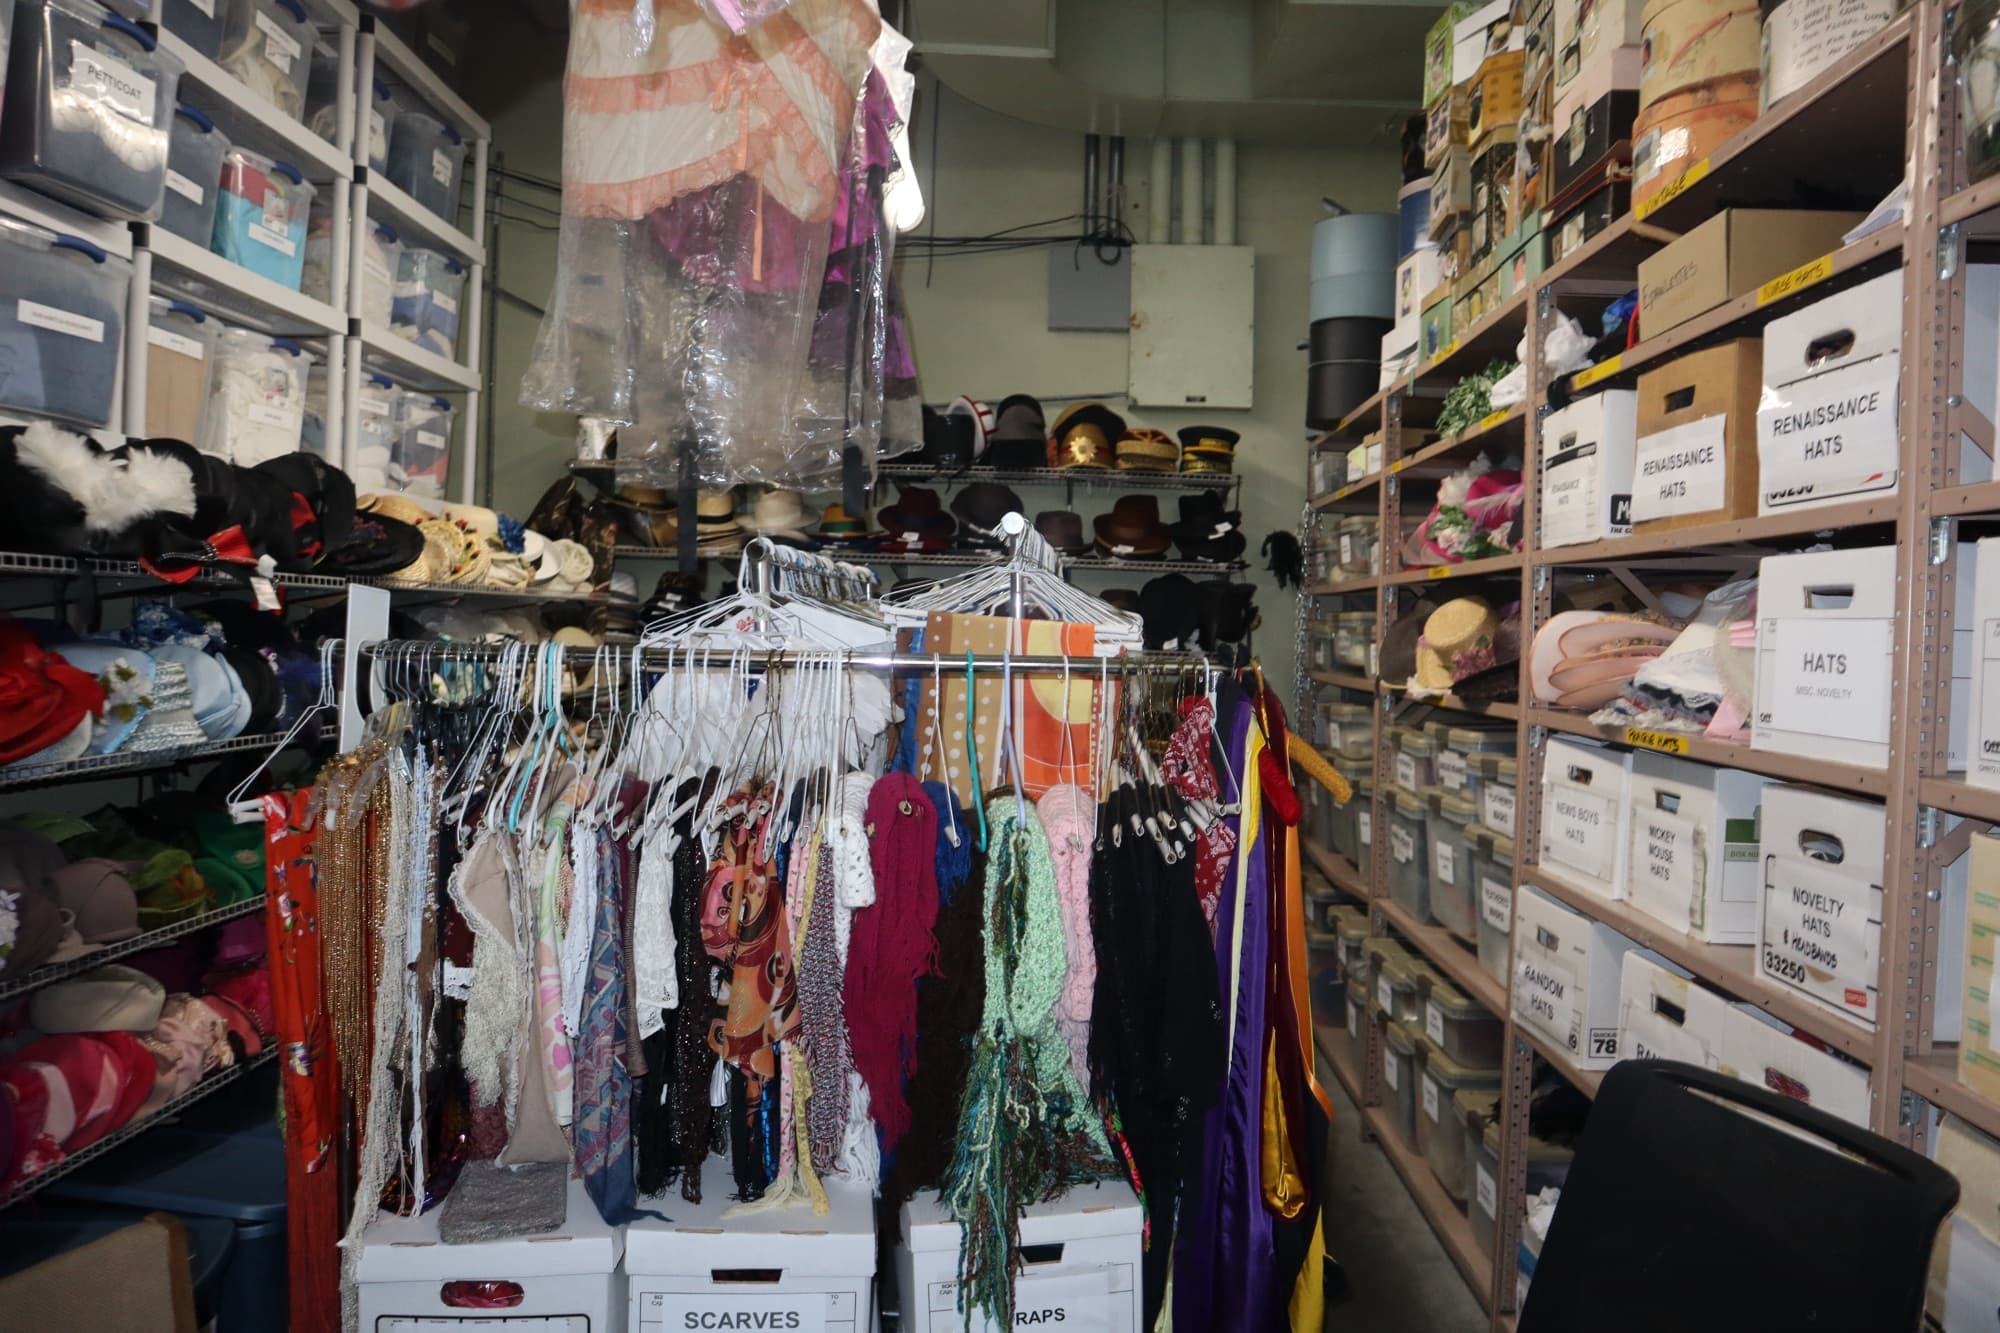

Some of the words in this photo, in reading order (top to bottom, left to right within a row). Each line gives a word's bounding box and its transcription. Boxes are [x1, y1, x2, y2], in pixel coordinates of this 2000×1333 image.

[87, 64, 142, 100] PETTICOAT
[1773, 391, 1880, 438] RENAISSANCE
[1804, 434, 1843, 461] HATS
[1642, 445, 1714, 477] RENAISSANCE
[1659, 480, 1687, 500] HATS
[1803, 652, 1847, 675] HATS
[1556, 801, 1577, 820] NEWS
[1578, 807, 1600, 825] BOYS
[1565, 827, 1585, 844] HATS
[1649, 825, 1676, 844] MICKEY
[1649, 842, 1674, 864] MOUSE
[1650, 864, 1671, 881] HATS
[1793, 887, 1845, 917] NOVELTY
[1802, 914, 1831, 938] HATS
[1791, 931, 1838, 969] HEADBANDS
[1766, 951, 1806, 983] 33250
[1524, 965, 1564, 1000] RANDOM
[1531, 994, 1554, 1021] HATS
[684, 1311, 801, 1330] SCARVES
[1015, 1307, 1066, 1326] RAPS
